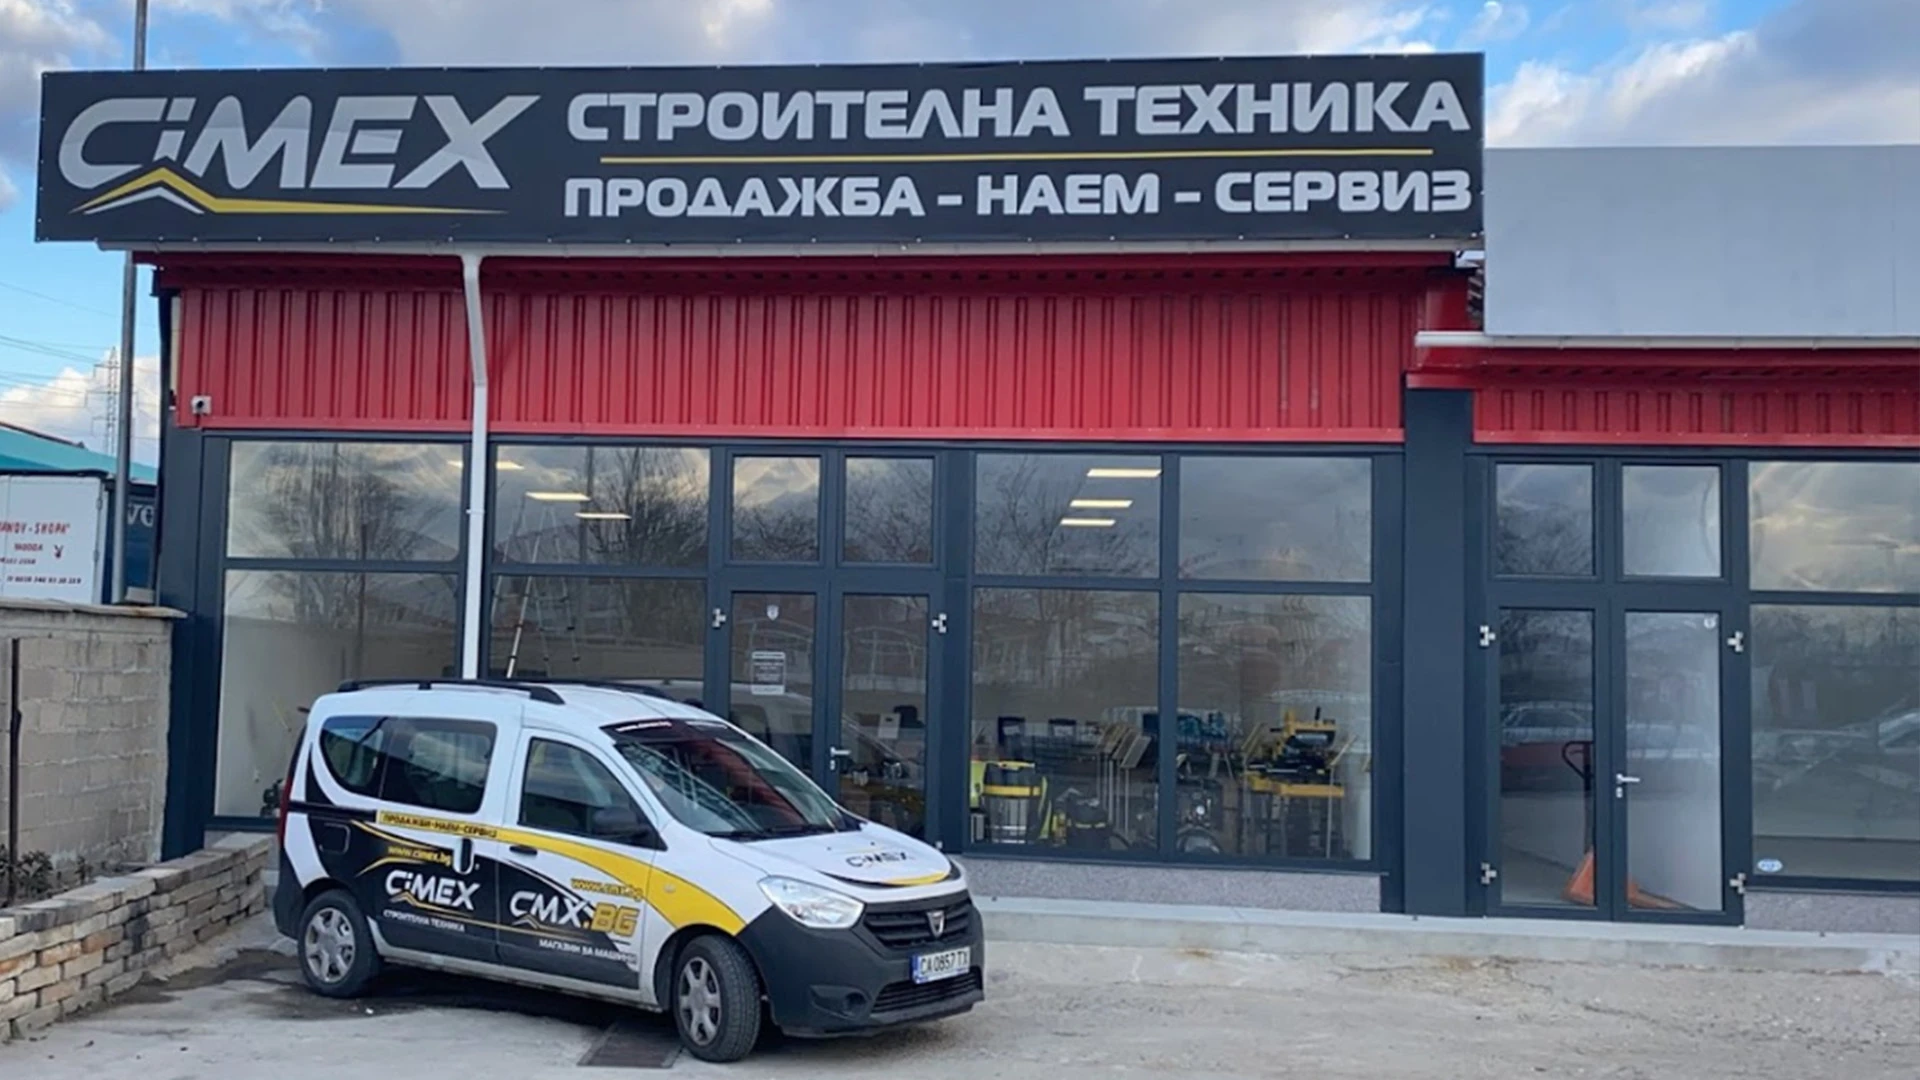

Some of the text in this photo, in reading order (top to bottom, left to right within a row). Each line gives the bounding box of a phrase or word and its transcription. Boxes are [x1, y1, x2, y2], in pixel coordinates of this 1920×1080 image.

[567, 81, 1471, 141] СТРОИТЕЛНА ТЕХНИКА
[564, 175, 926, 217] ПРОДАЖБА
[976, 173, 1160, 216] НАЕМ
[1215, 169, 1472, 213] СЕРВИЗ
